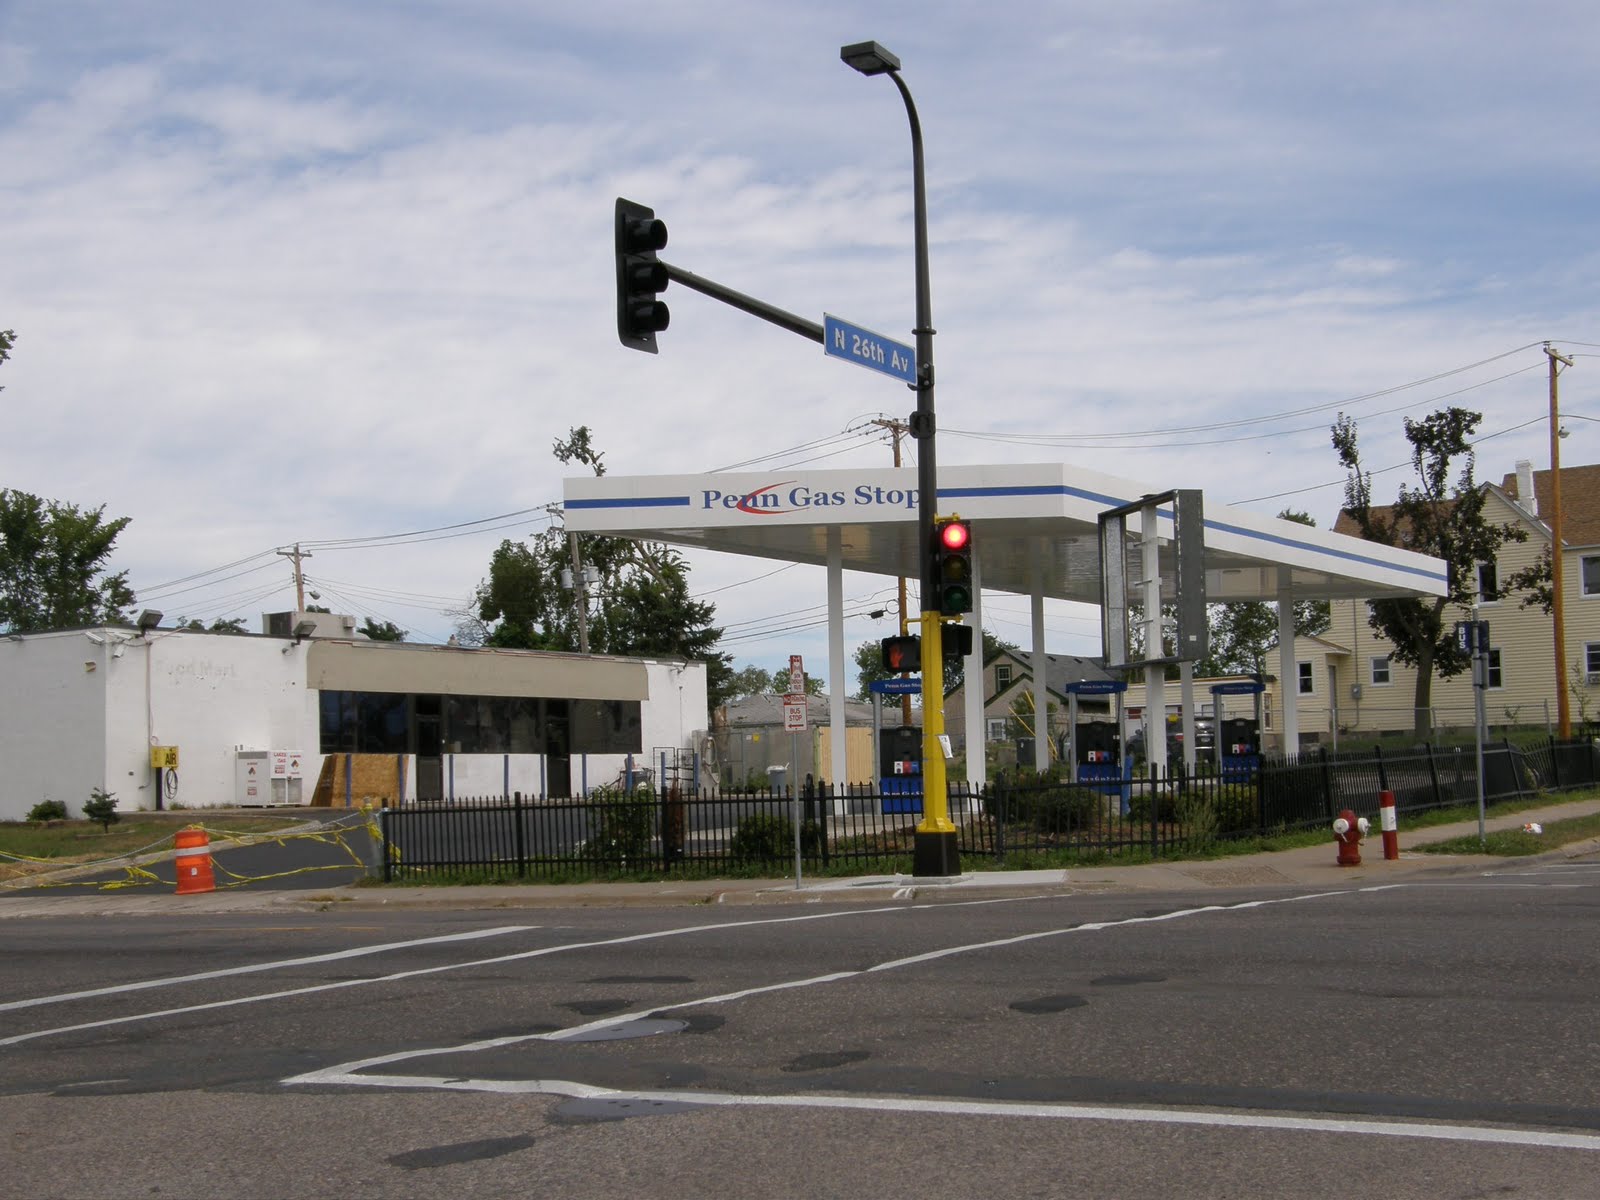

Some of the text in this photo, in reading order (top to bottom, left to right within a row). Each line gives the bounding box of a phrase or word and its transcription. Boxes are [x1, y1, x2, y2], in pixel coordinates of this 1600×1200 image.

[835, 328, 908, 372] N 26th Av
[702, 485, 919, 509] Penn Gas Stop
[1458, 627, 1466, 649] BUS
[788, 714, 803, 722] STOP
[789, 707, 801, 715] BUS
[164, 753, 177, 765] AIR
